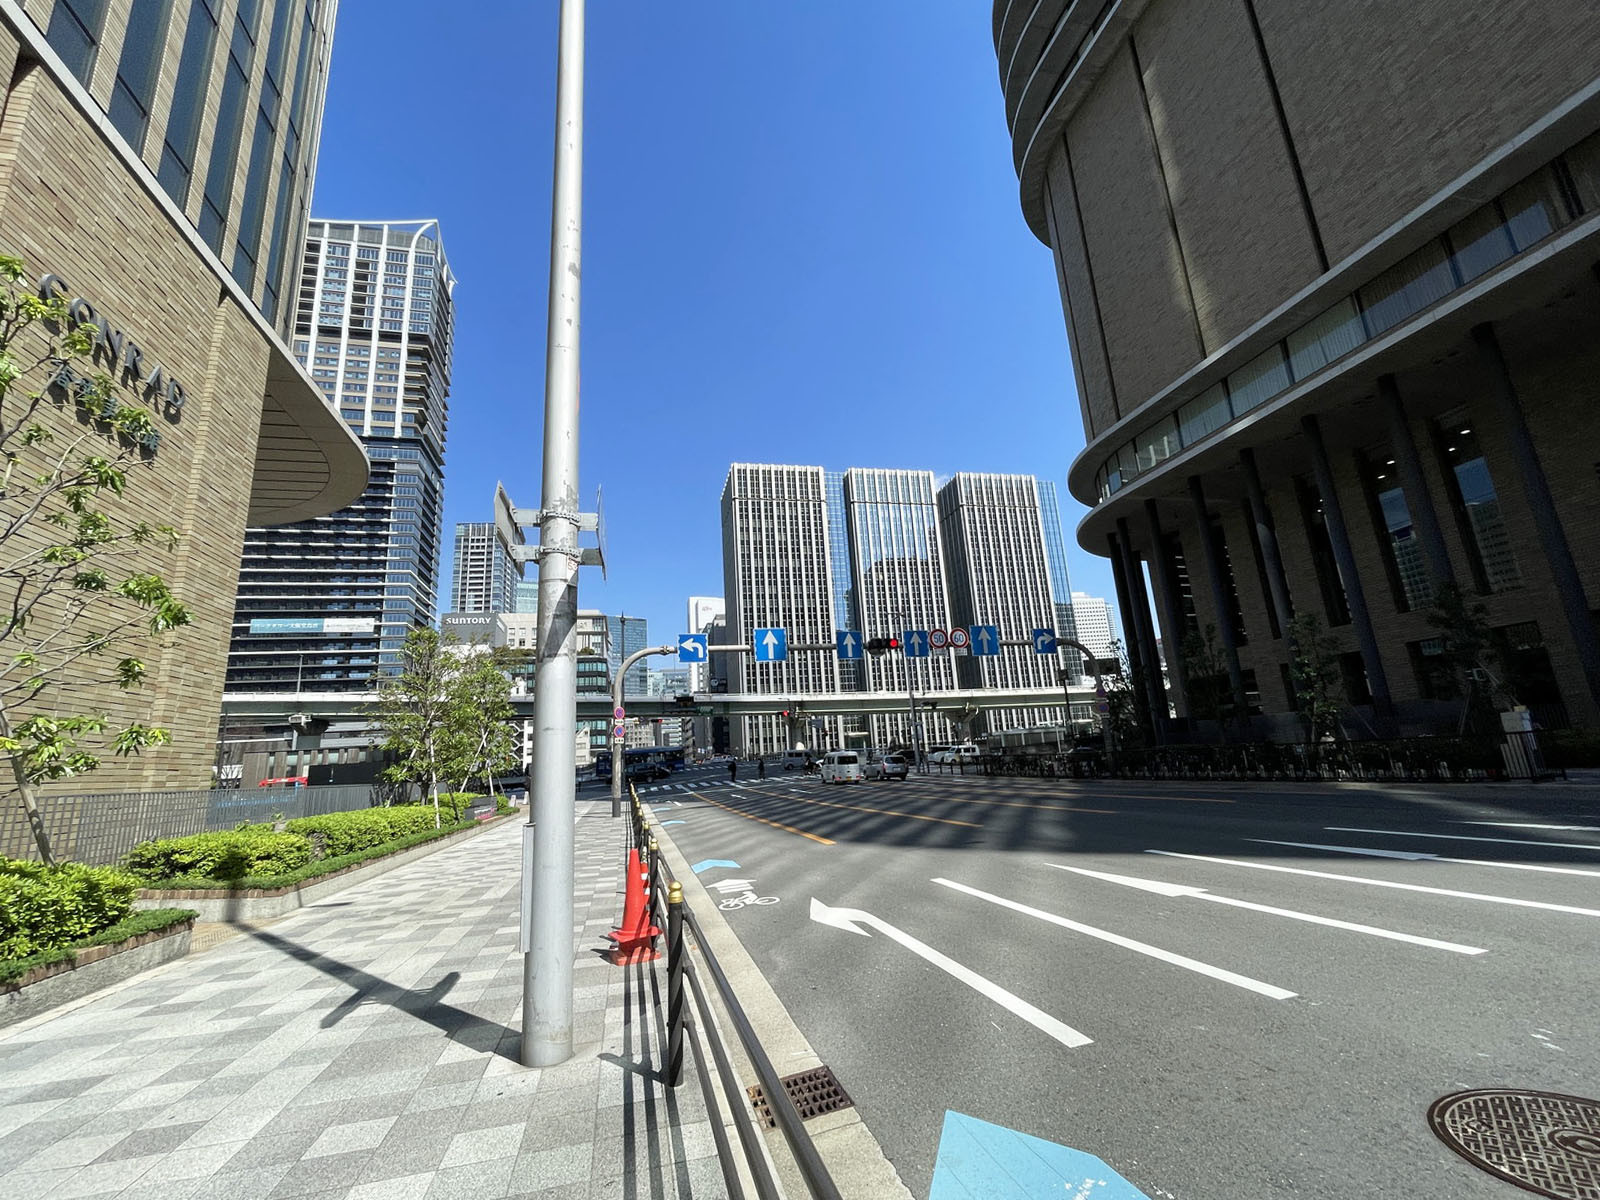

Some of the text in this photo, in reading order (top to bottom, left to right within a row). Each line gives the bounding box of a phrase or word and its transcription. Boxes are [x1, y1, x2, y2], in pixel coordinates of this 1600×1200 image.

[38, 273, 186, 409] CONRAD
[446, 617, 492, 625] SUNTORY
[933, 633, 944, 644] 50
[954, 633, 964, 643] 60
